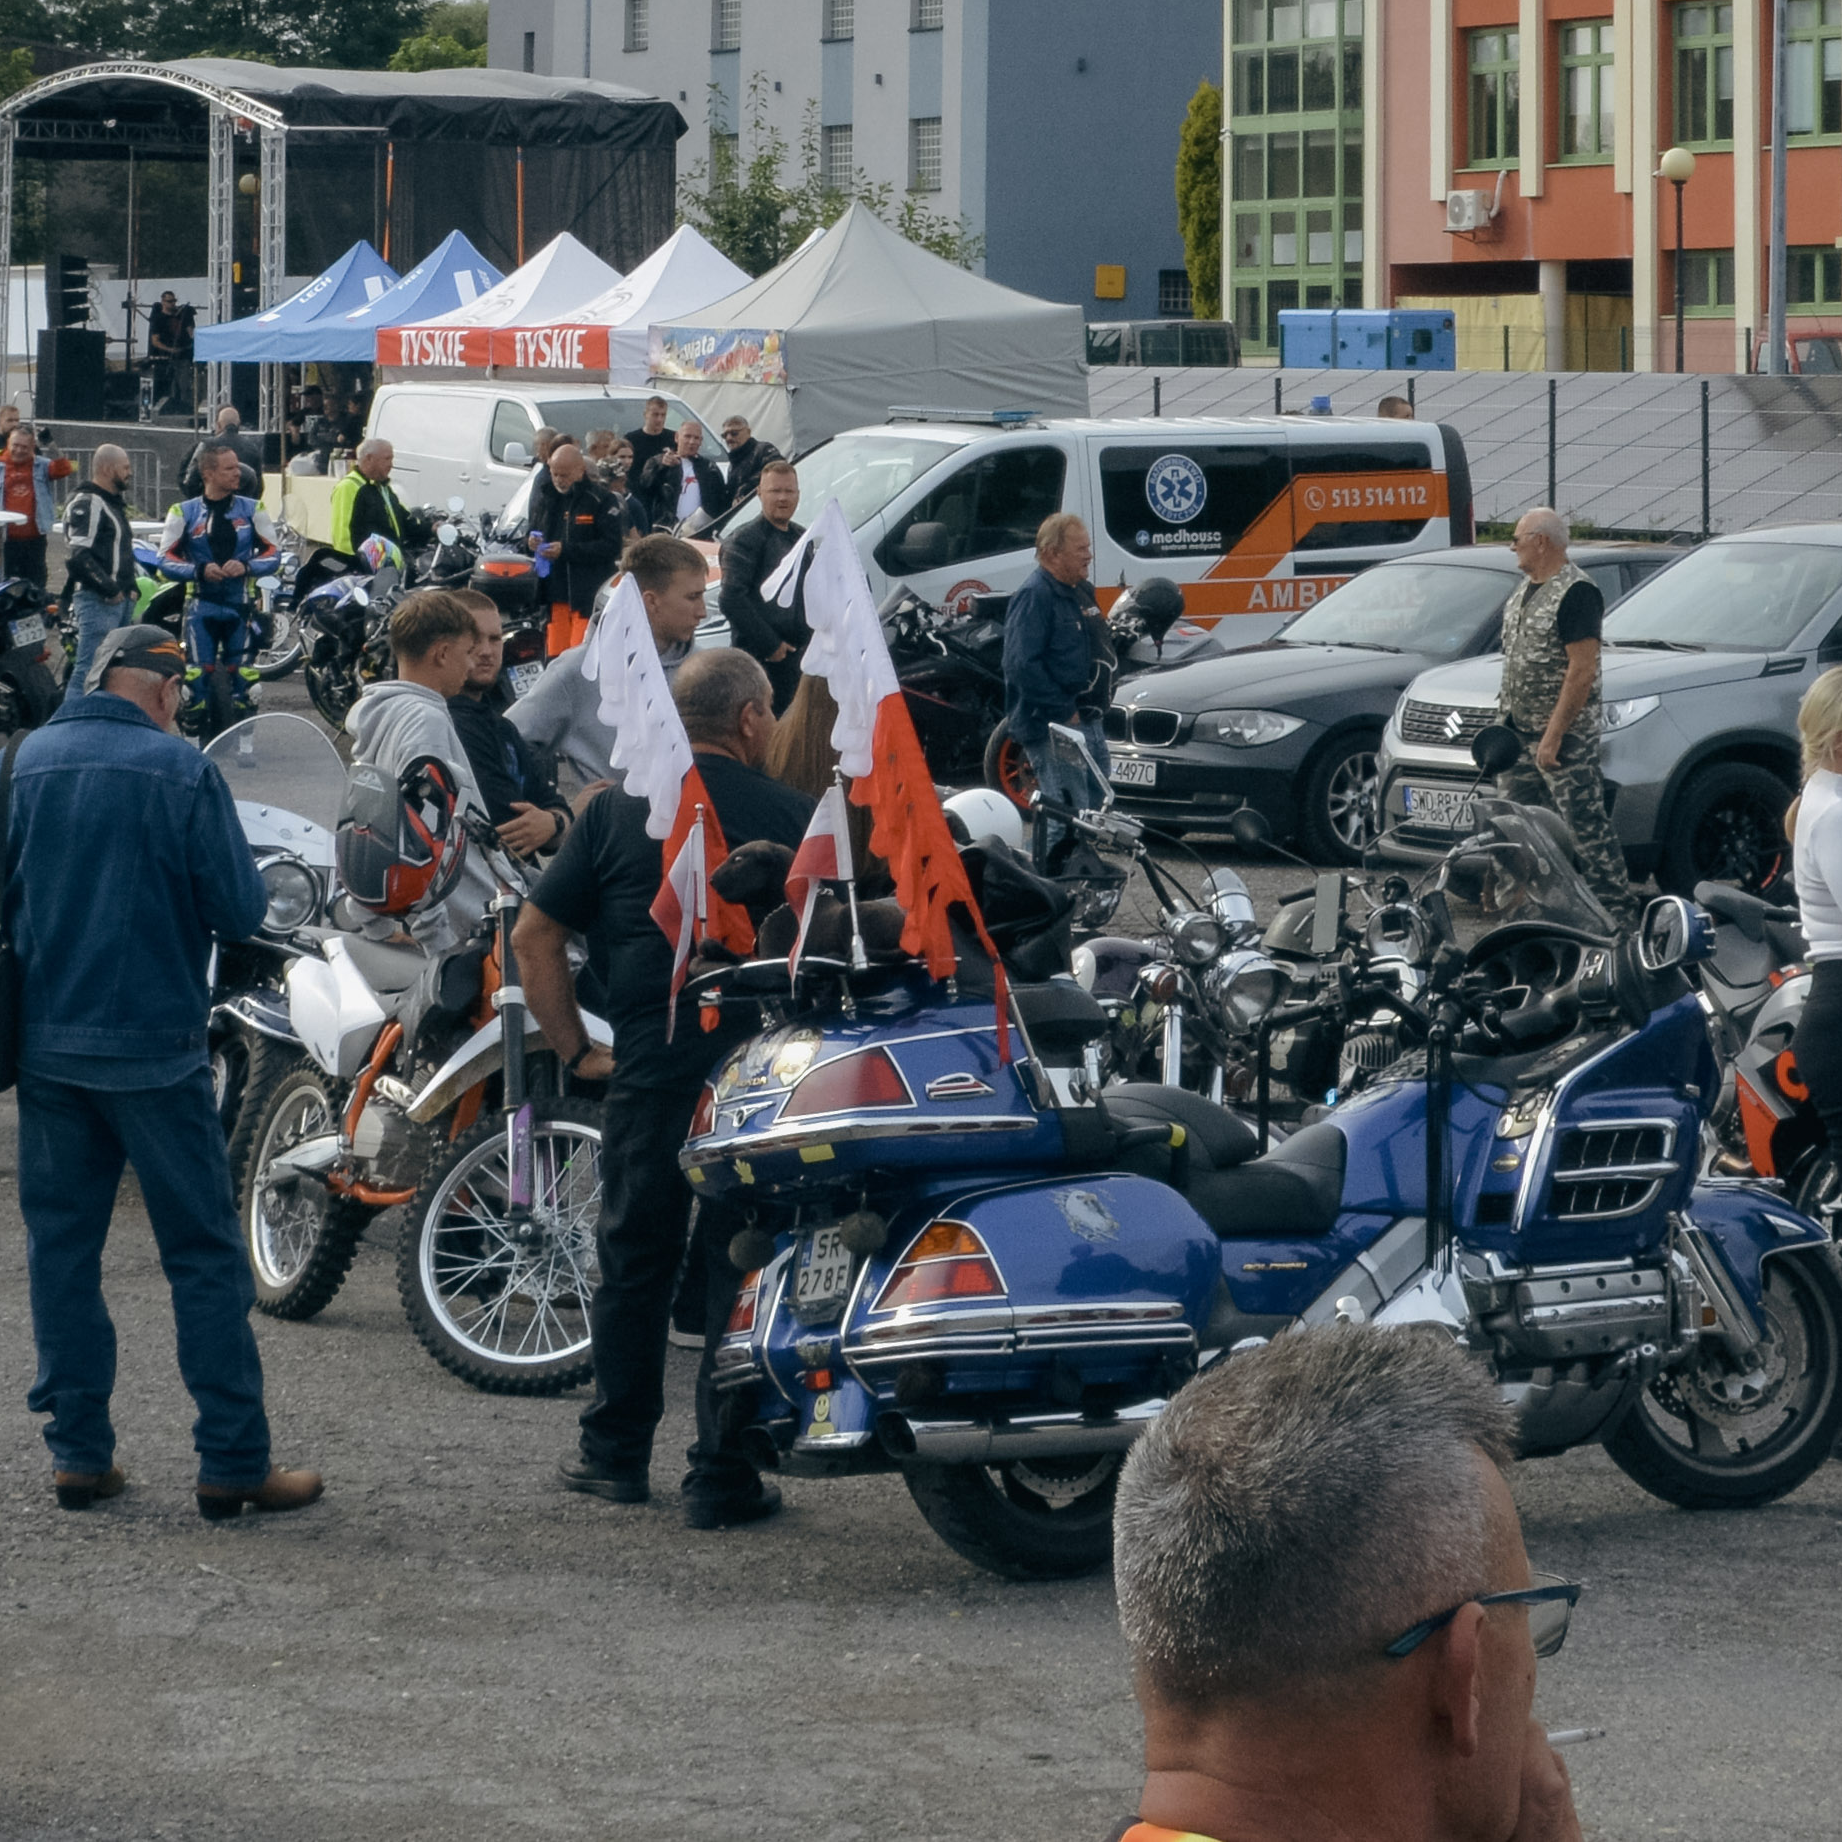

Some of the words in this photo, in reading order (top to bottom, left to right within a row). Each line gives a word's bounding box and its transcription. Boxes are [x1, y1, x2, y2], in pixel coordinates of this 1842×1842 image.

[299, 277, 332, 304] LECH
[399, 329, 470, 367] TYSKIE
[514, 328, 588, 369] TYSKIE
[1332, 488, 1361, 507] 513
[1365, 487, 1395, 506] 514
[1398, 486, 1427, 505] 112
[1152, 529, 1222, 544] medhouse
[1115, 761, 1154, 784] 4497C
